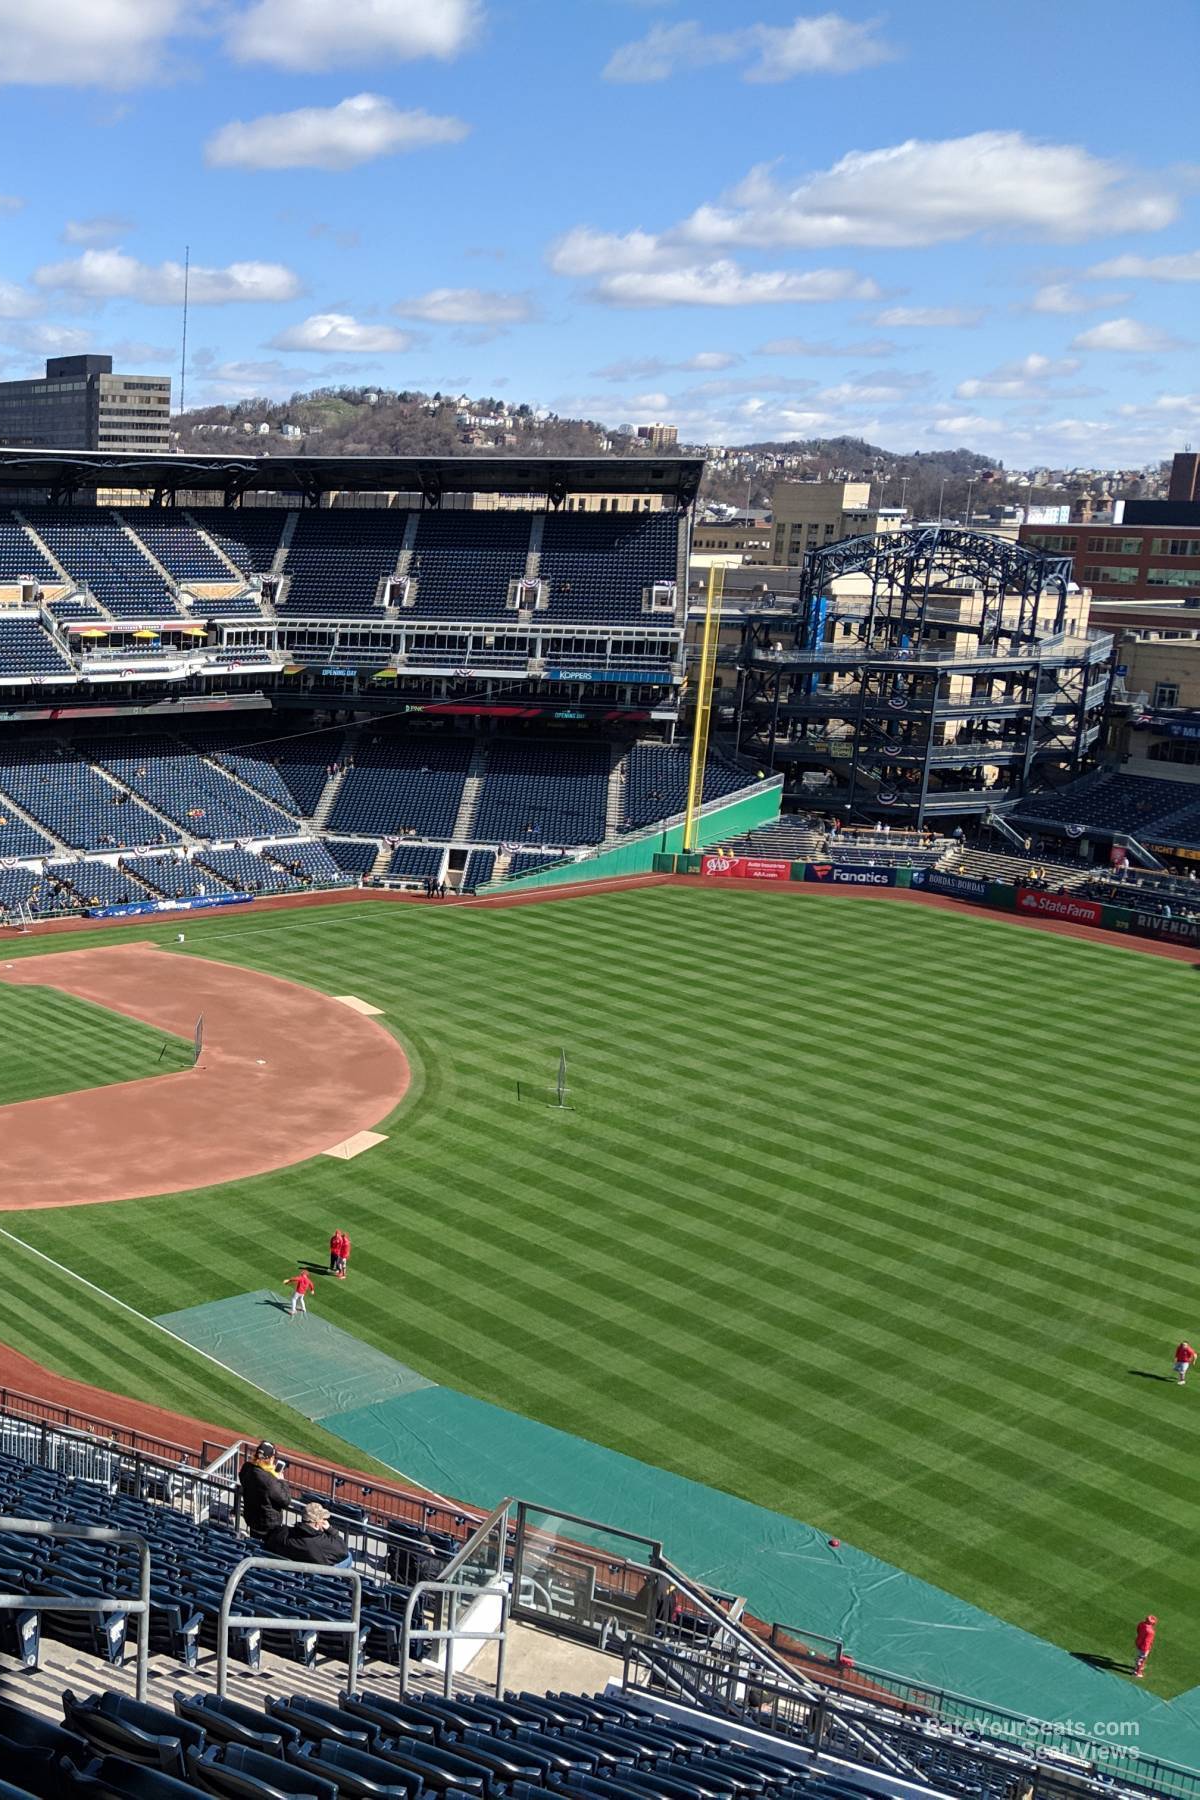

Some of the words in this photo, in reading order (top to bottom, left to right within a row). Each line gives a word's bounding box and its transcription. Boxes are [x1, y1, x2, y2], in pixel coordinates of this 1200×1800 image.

[321, 669, 346, 677] OPENING
[559, 670, 592, 680] KOPPERS
[709, 860, 727, 871] AAA
[833, 869, 889, 884] Fanatics
